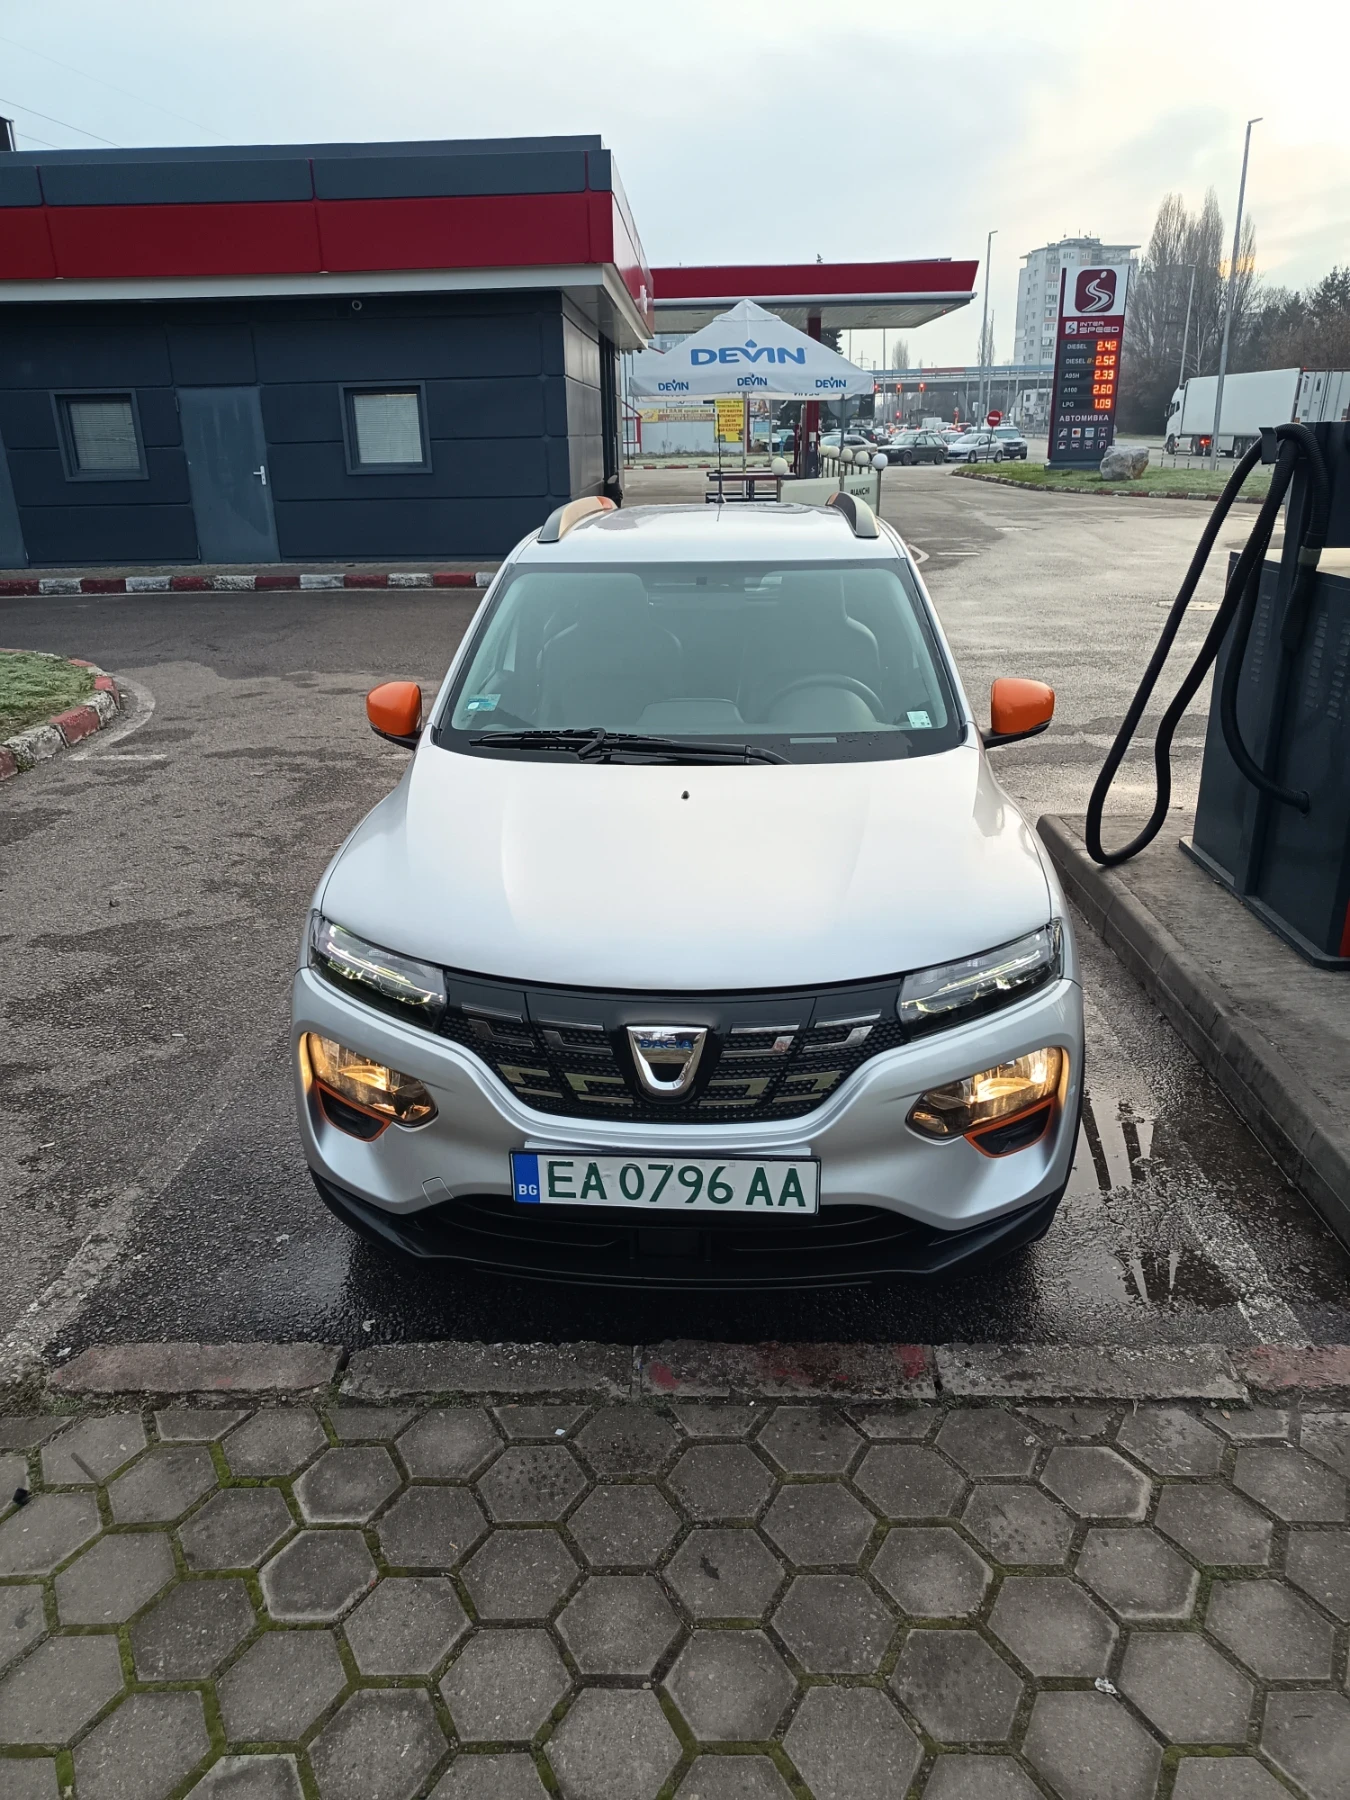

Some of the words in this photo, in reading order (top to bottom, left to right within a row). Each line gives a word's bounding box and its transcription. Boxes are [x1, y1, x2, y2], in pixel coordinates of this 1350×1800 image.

[1096, 341, 1117, 351] 2.42
[690, 346, 806, 366] DEVIN
[1095, 355, 1116, 366] 2.52
[1094, 370, 1114, 380] 2.33
[657, 381, 690, 392] DEVIN
[736, 376, 768, 387] DEVIN
[815, 379, 847, 389] DEVIN
[1092, 384, 1113, 394] 2.60
[1094, 399, 1111, 409] 1.09
[1059, 414, 1109, 422] АВТОМИВКА
[639, 1038, 694, 1049] DACIA
[518, 1183, 538, 1195] BG
[547, 1160, 607, 1200] EA
[619, 1162, 734, 1205] 0796
[745, 1166, 806, 1207] AA
